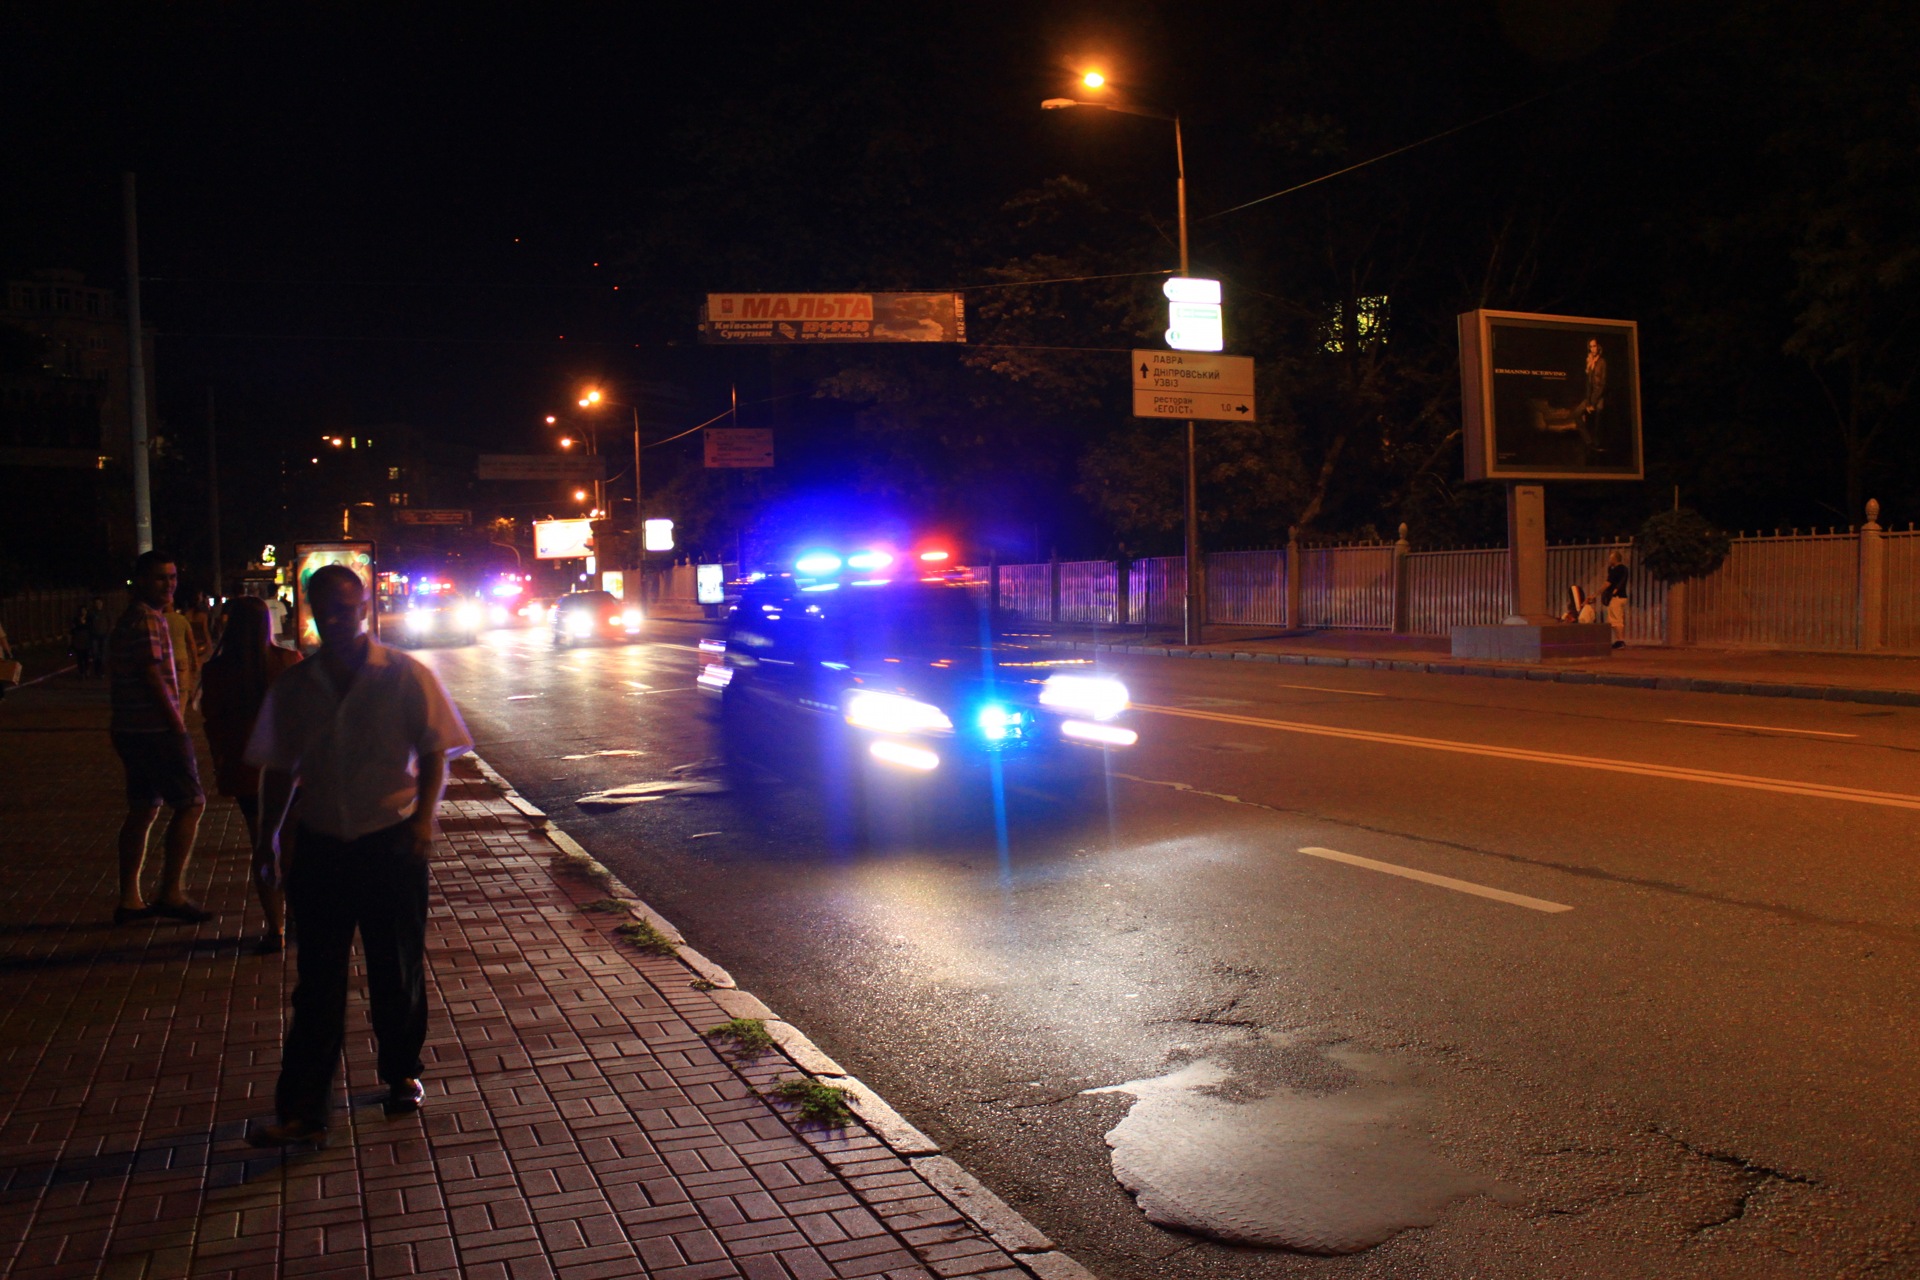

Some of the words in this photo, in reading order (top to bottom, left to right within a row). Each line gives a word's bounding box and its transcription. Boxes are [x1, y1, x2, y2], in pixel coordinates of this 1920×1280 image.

[742, 297, 872, 319] МАЛЬТА
[714, 321, 774, 330] Київський
[719, 330, 773, 339] Супутник
[1153, 355, 1183, 365] ЛАВРА
[1153, 367, 1220, 380] ДНІПРОВСЬКИЙ
[1154, 378, 1179, 388] УЗВІЗ
[1153, 396, 1193, 405] ресторан
